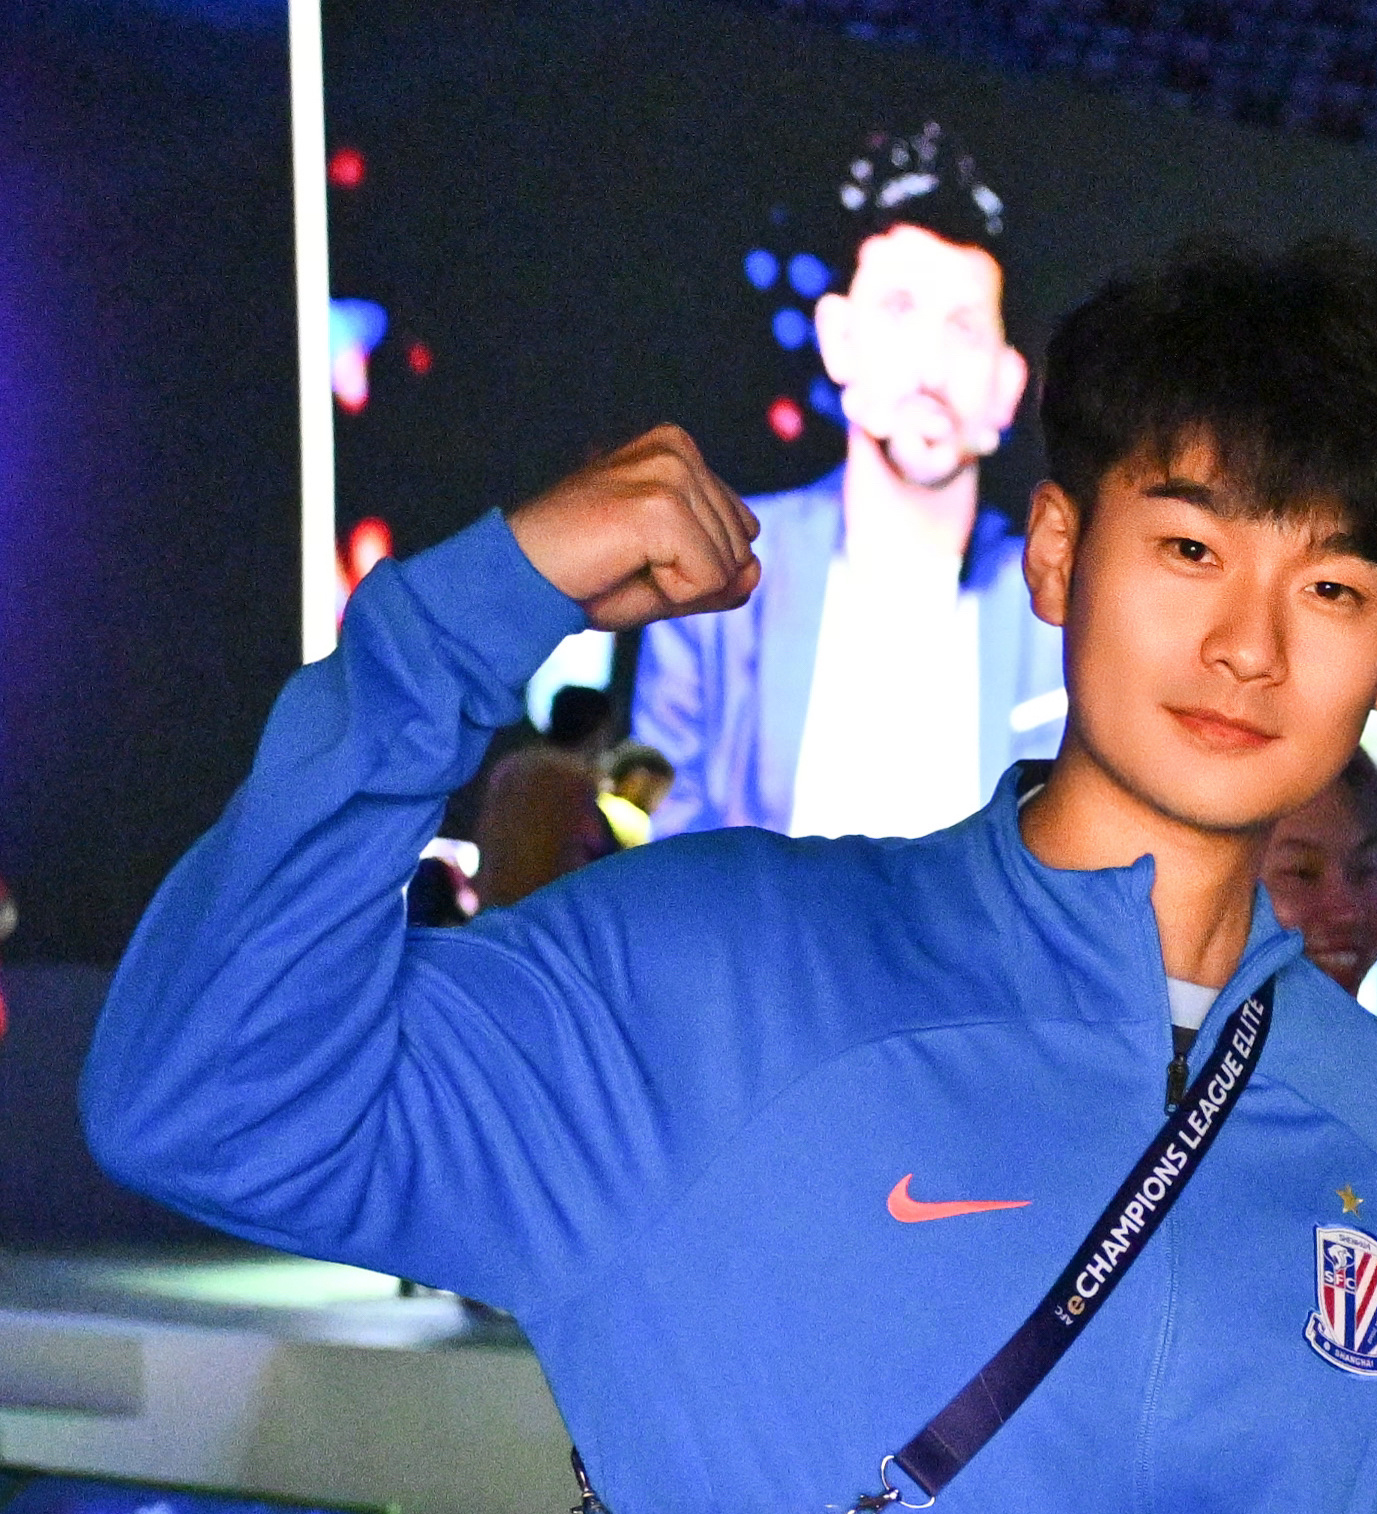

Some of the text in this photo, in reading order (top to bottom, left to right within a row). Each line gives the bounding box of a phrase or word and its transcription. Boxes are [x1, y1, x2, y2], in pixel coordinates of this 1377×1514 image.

[1066, 996, 1266, 1316] eCHAMPIONS LEAGUE ELITE
[1053, 1305, 1075, 1326] AFC
